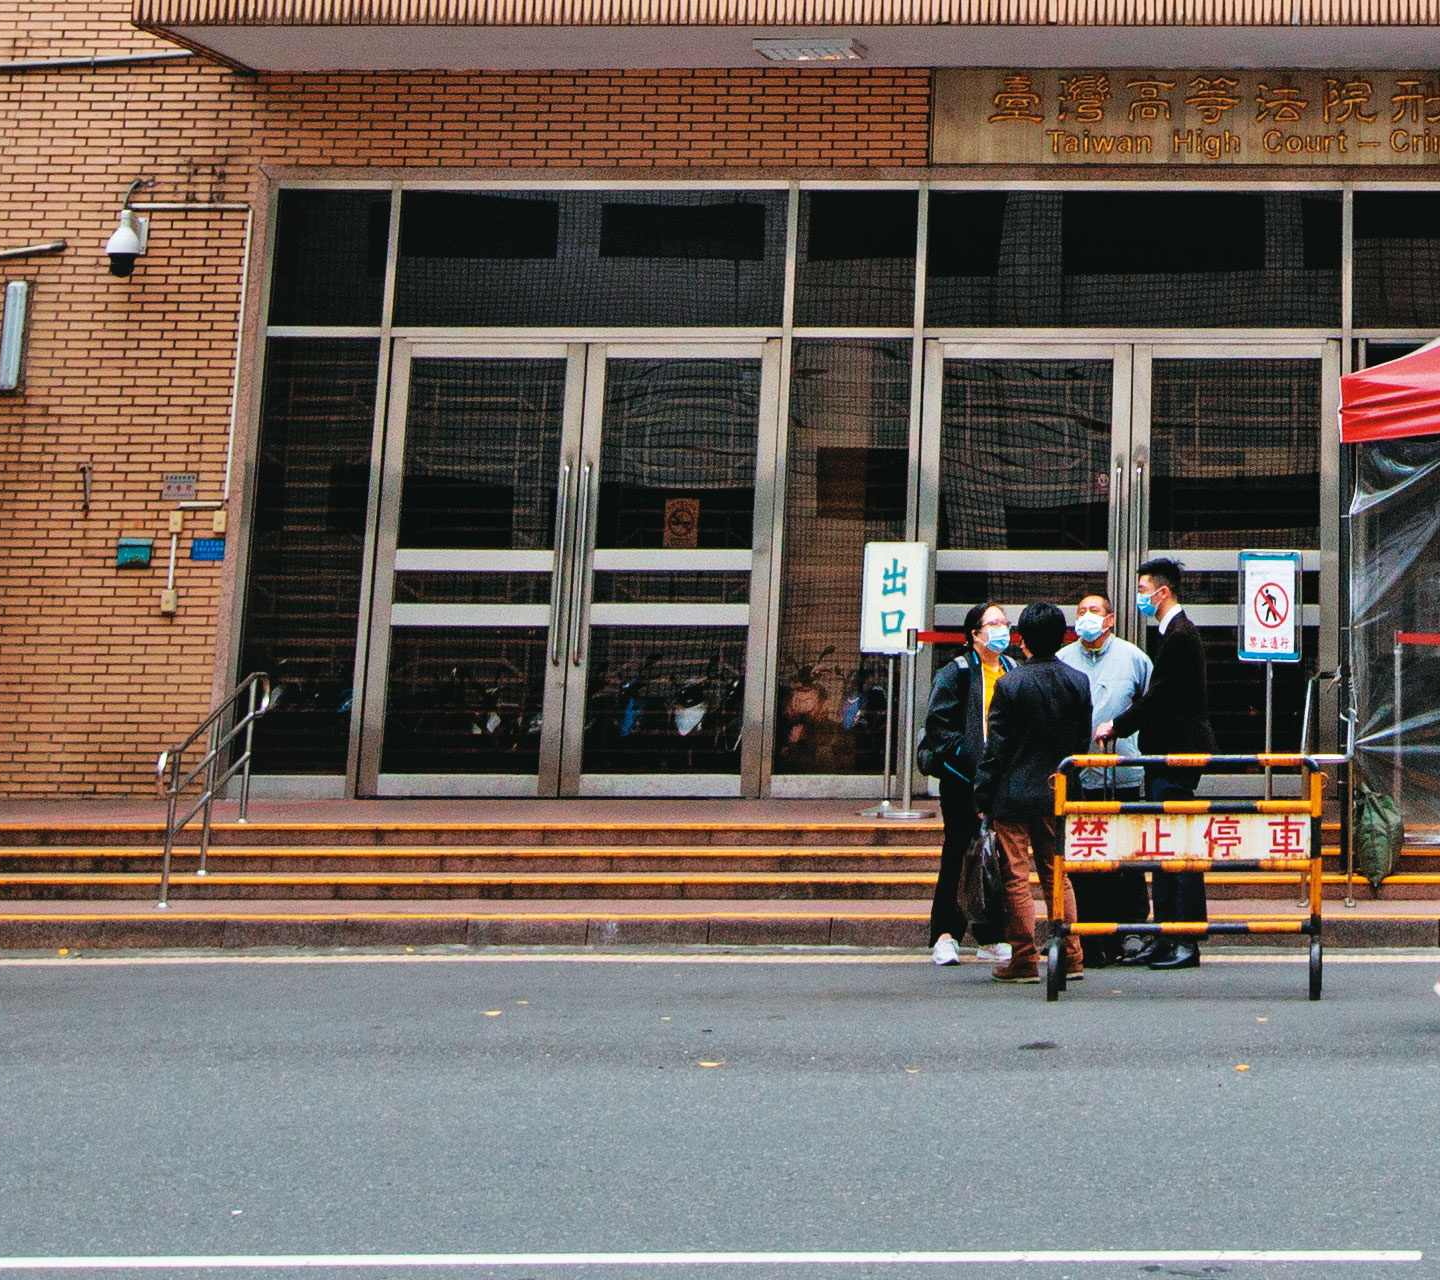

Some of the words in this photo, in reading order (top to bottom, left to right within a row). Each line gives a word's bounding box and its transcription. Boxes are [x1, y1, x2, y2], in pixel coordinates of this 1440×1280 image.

[1046, 130, 1152, 154] Taiwan
[1173, 130, 1240, 160] High
[1263, 130, 1348, 154] Court
[881, 558, 907, 637] 出口
[1250, 637, 1289, 649] 禁止通行
[1070, 815, 1306, 857] 禁止停車
